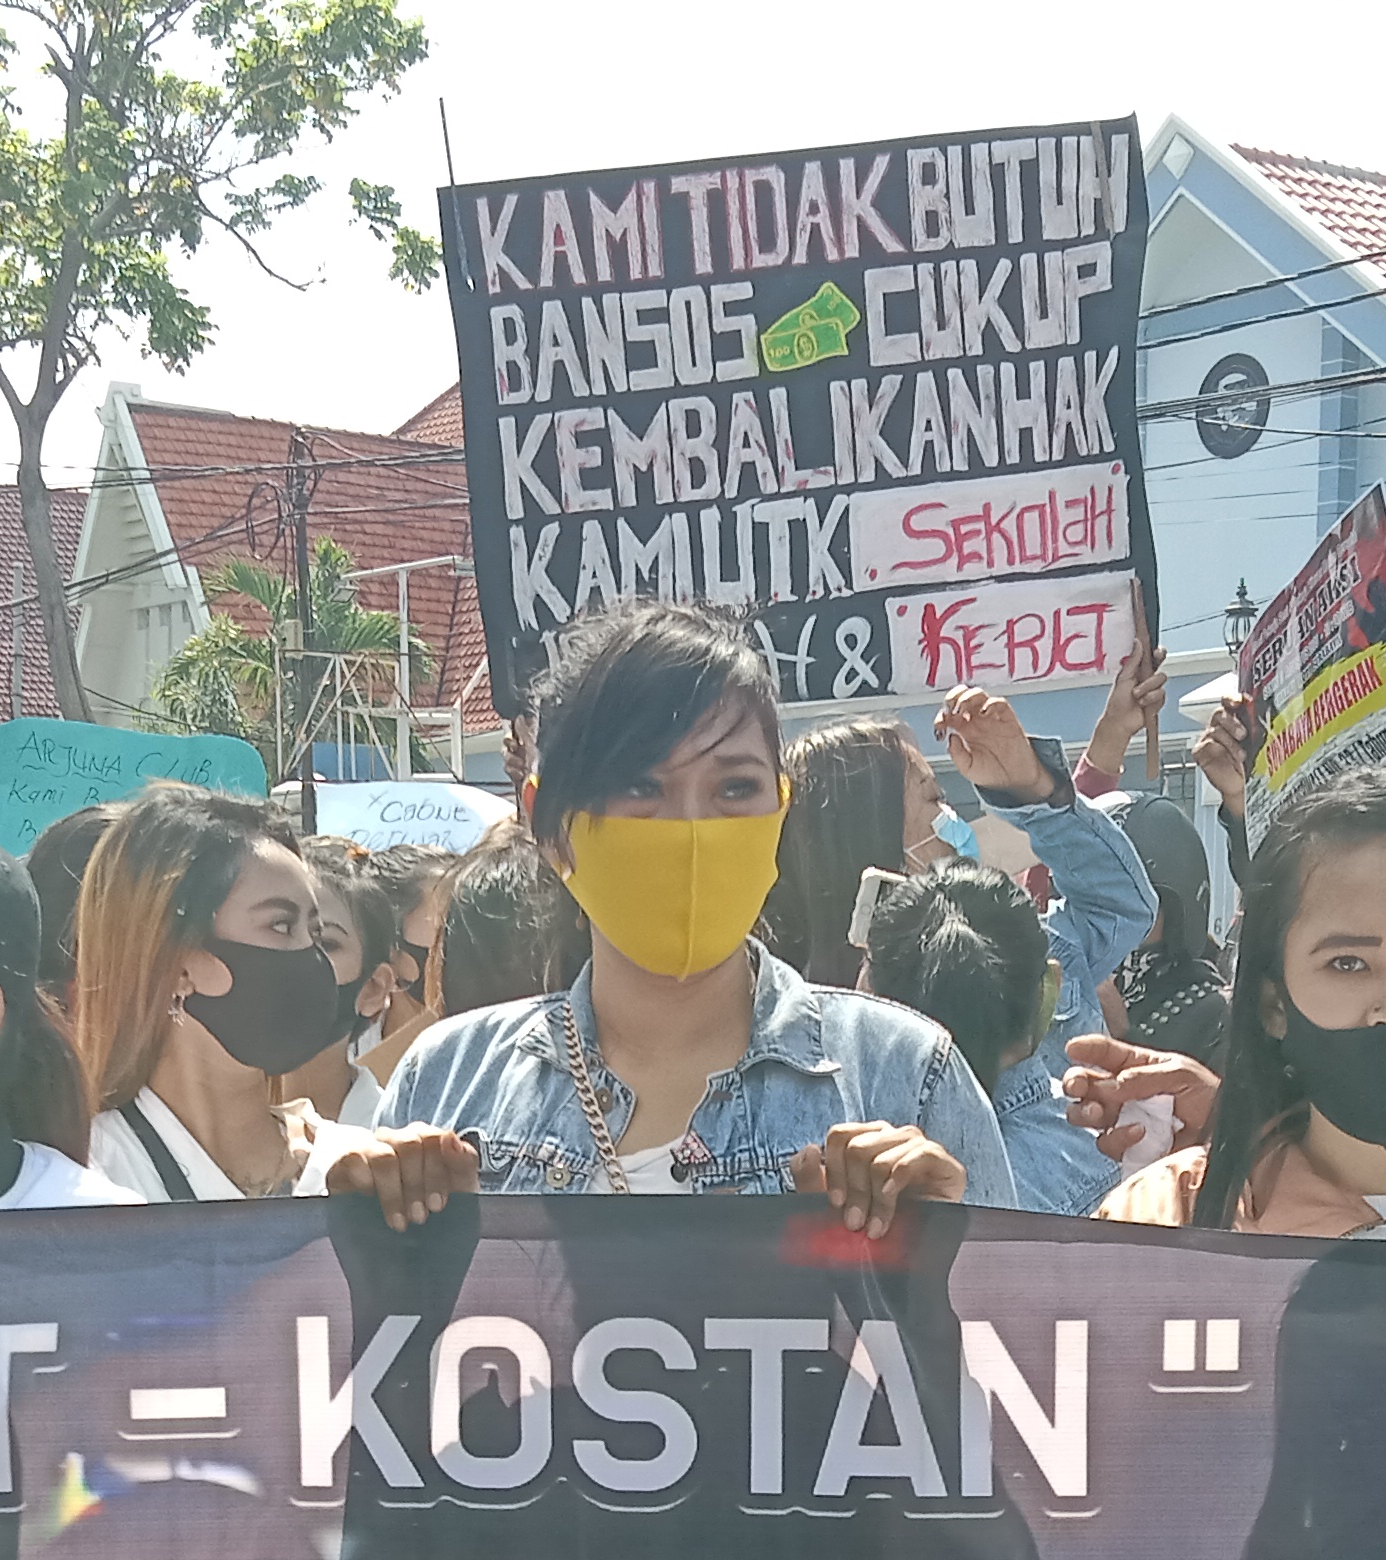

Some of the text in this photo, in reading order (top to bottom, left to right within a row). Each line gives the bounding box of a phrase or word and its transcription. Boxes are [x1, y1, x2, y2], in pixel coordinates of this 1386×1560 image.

[477, 133, 1130, 295] KAMI TIDAK BUTUH
[489, 241, 1112, 405] BANSOS CUKUP
[296, 1314, 1088, 1497] KOSTAN
